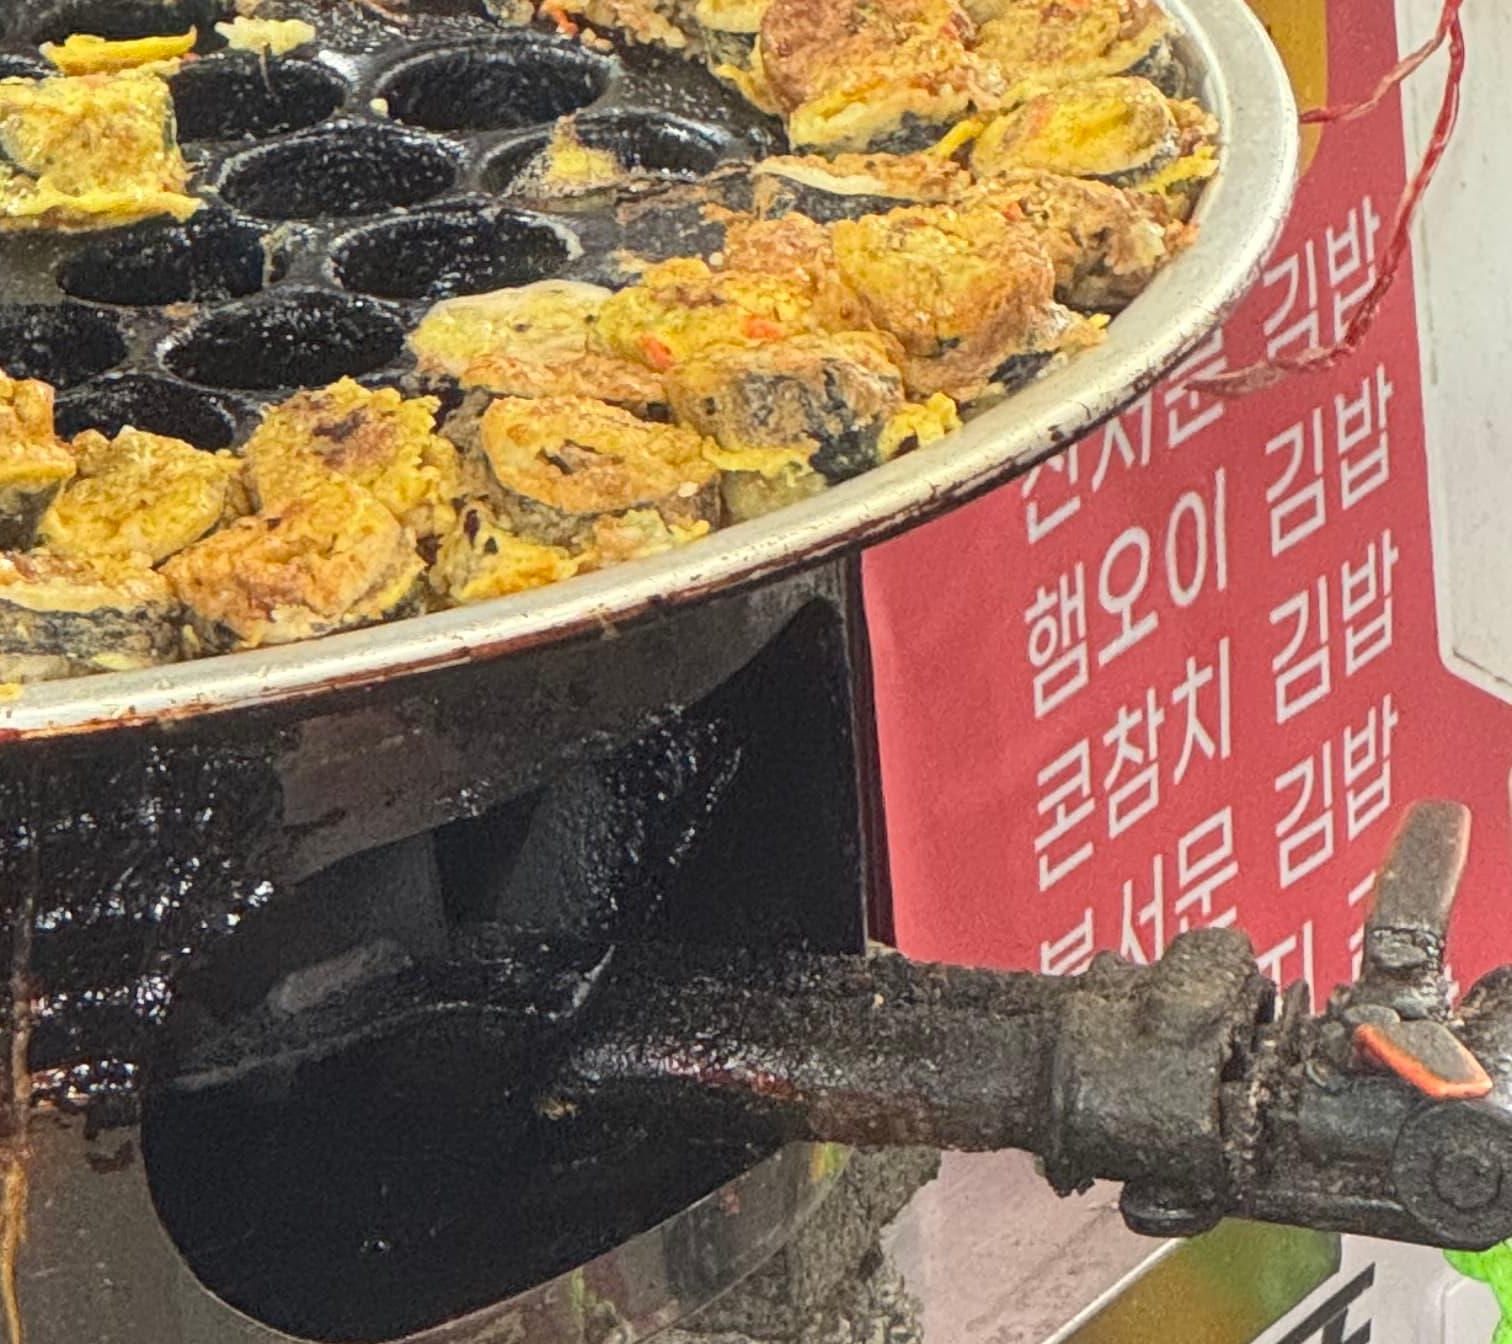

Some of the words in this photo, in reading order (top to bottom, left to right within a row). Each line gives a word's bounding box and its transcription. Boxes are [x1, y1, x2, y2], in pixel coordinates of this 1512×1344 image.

[1024, 466, 1228, 720] 햄오이
[1264, 363, 1394, 556] 김밥
[1033, 636, 1232, 893] 콘참치
[1269, 529, 1399, 725] 김밥
[1274, 694, 1399, 889] 김밥
